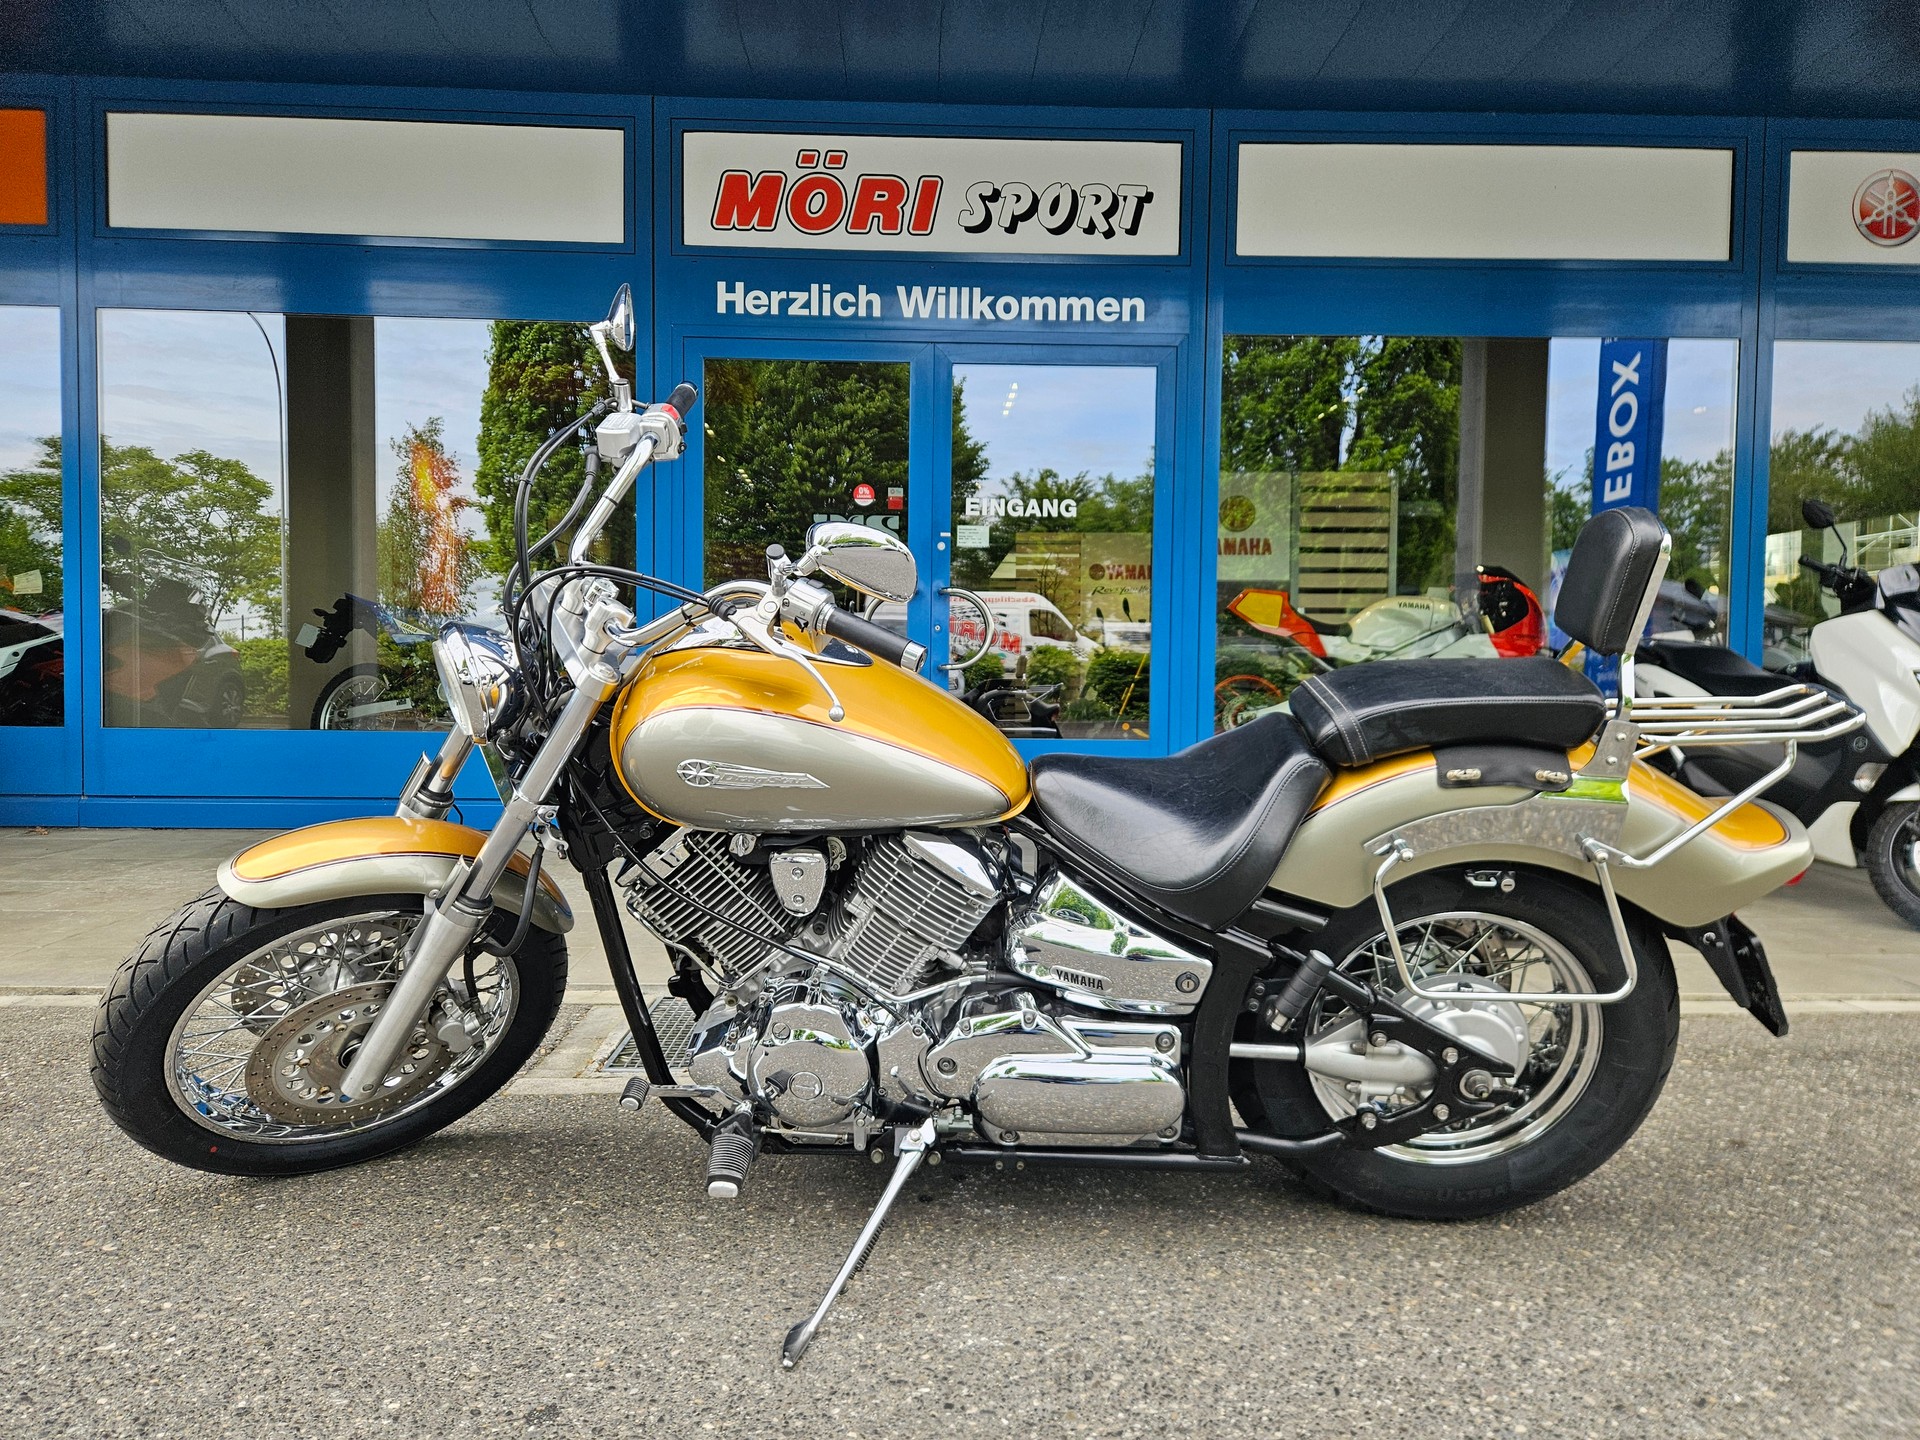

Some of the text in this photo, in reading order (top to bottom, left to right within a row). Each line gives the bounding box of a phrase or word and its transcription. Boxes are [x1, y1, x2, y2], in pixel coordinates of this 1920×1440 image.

[711, 149, 1154, 240] MÖRI SPORT
[716, 281, 1146, 323] Herzlich Willkommen
[965, 498, 1077, 518] EINGANG
[1398, 601, 1431, 611] YAMAHA
[1056, 969, 1104, 990] YAMAHA
